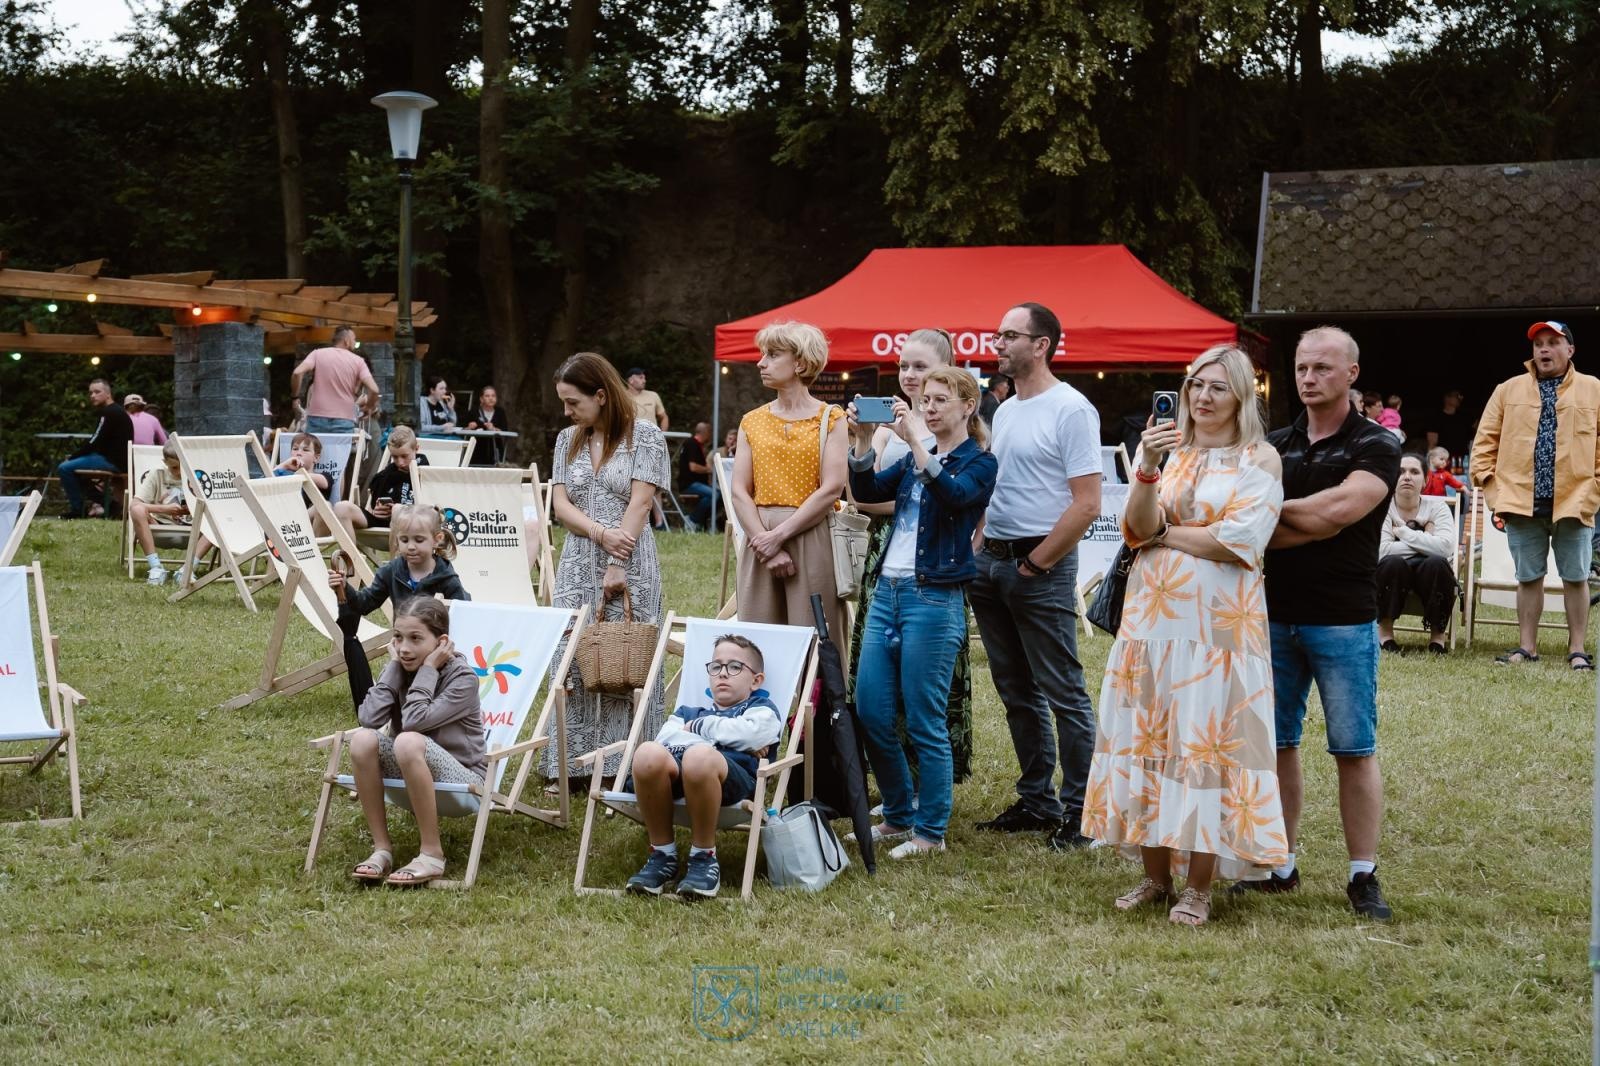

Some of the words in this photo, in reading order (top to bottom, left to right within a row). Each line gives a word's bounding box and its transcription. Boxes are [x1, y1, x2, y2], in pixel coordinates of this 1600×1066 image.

[872, 333, 908, 356] OS
[210, 469, 236, 480] stacja
[212, 480, 234, 489] kultu
[468, 509, 507, 525] stacja
[1095, 514, 1117, 525] tacj
[470, 522, 517, 535] kultura
[1095, 523, 1120, 532] kultu
[482, 711, 514, 727] WAL
